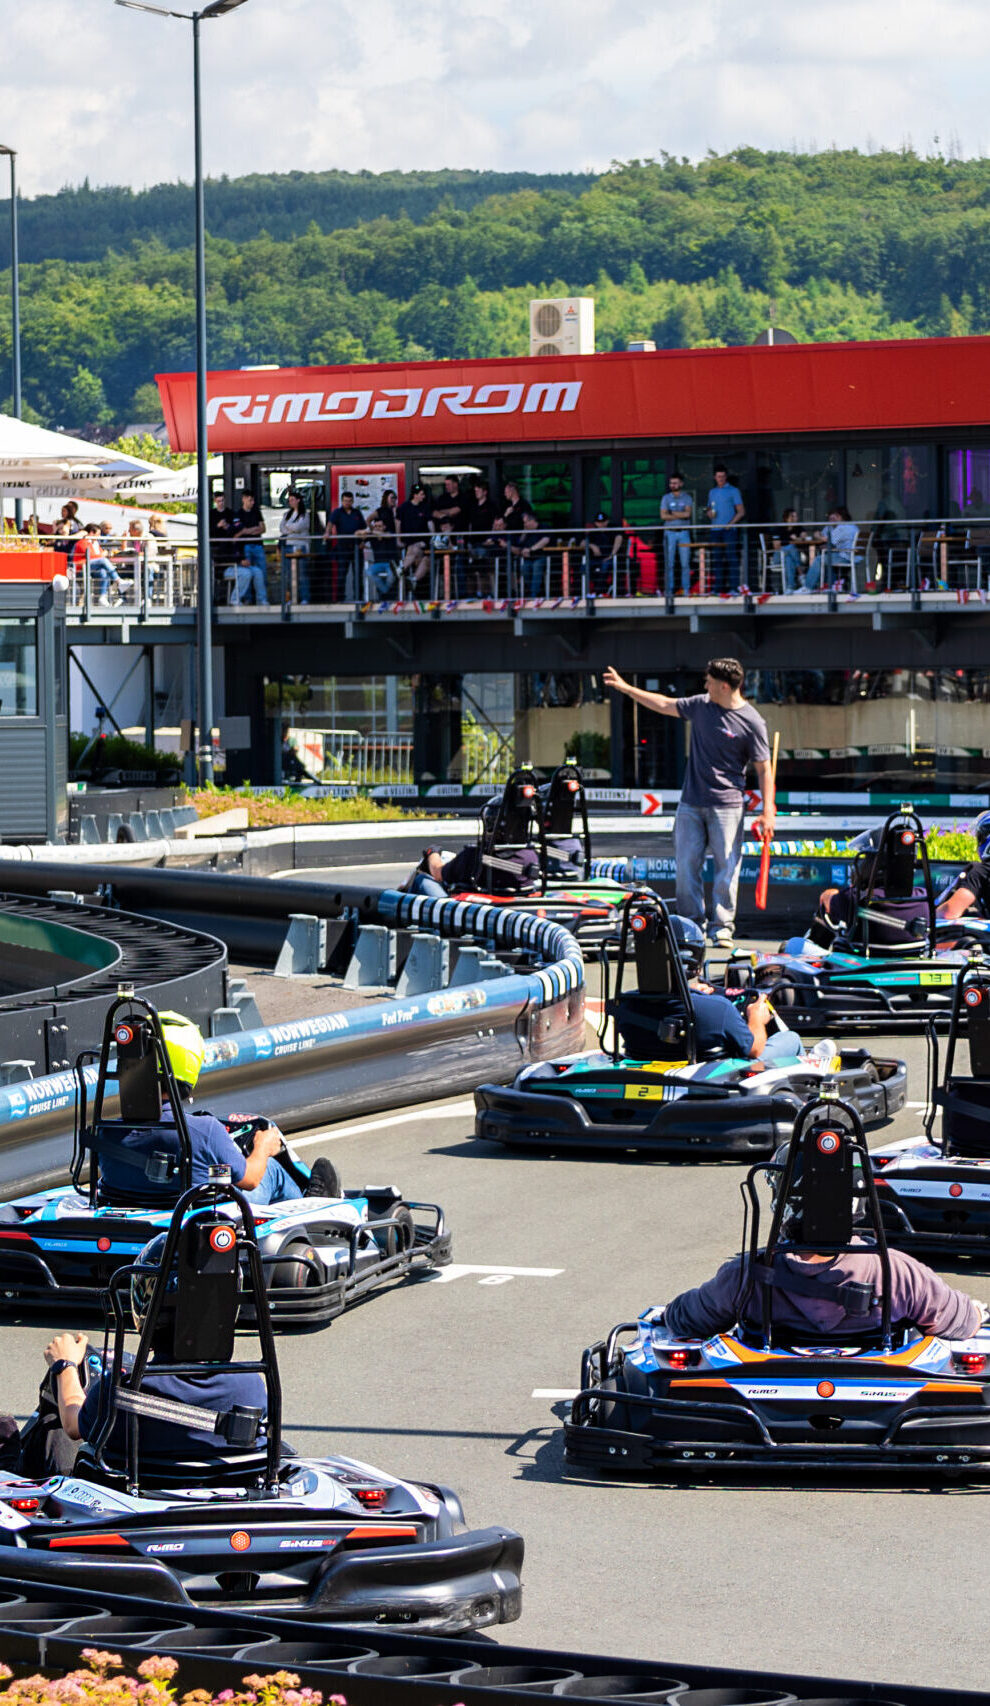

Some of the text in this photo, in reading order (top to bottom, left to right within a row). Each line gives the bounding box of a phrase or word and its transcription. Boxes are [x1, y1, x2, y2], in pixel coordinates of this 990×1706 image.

[594, 791, 626, 799] VELTINS
[269, 1013, 349, 1045] NORWEGIAN
[382, 1011, 397, 1026] Feel
[274, 1042, 298, 1056] CRUISE
[638, 1086, 649, 1097] 2
[29, 1102, 52, 1115] CRUISE
